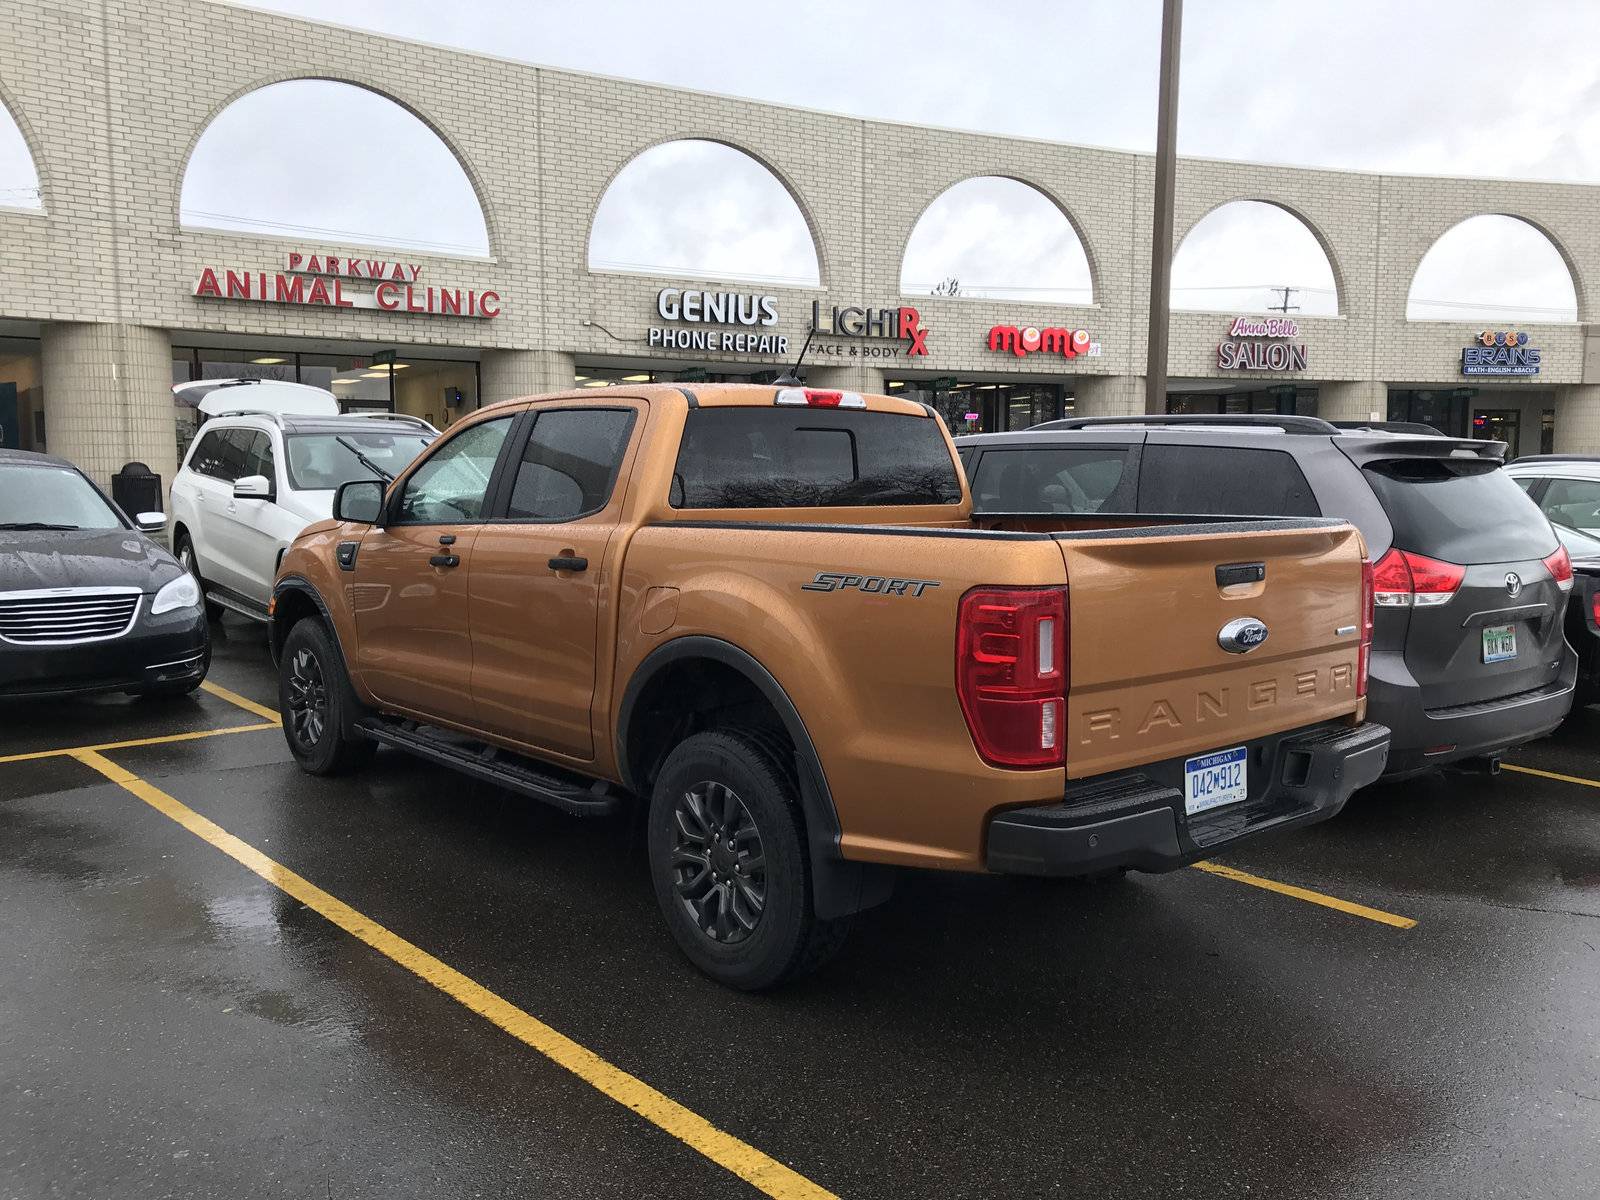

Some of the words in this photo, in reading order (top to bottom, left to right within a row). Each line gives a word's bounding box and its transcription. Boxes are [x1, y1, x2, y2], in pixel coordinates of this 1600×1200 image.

[288, 252, 422, 281] PARKWAY
[195, 266, 354, 308] ANIMAL
[375, 281, 501, 318] CLINIC
[657, 287, 779, 327] GENIUS
[648, 327, 717, 351] PHONE
[721, 331, 789, 354] REPAIR
[808, 343, 843, 356] FACE
[849, 346, 858, 356] &
[862, 346, 899, 358] BODY
[1484, 333, 1527, 345] BEST
[1218, 341, 1308, 371] SALON
[1464, 348, 1541, 365] BRAINS
[801, 572, 941, 598] SPORT
[1081, 662, 1353, 745] RANGER
[1200, 752, 1233, 768] MICHIGAN
[1192, 763, 1241, 798] 042M912
